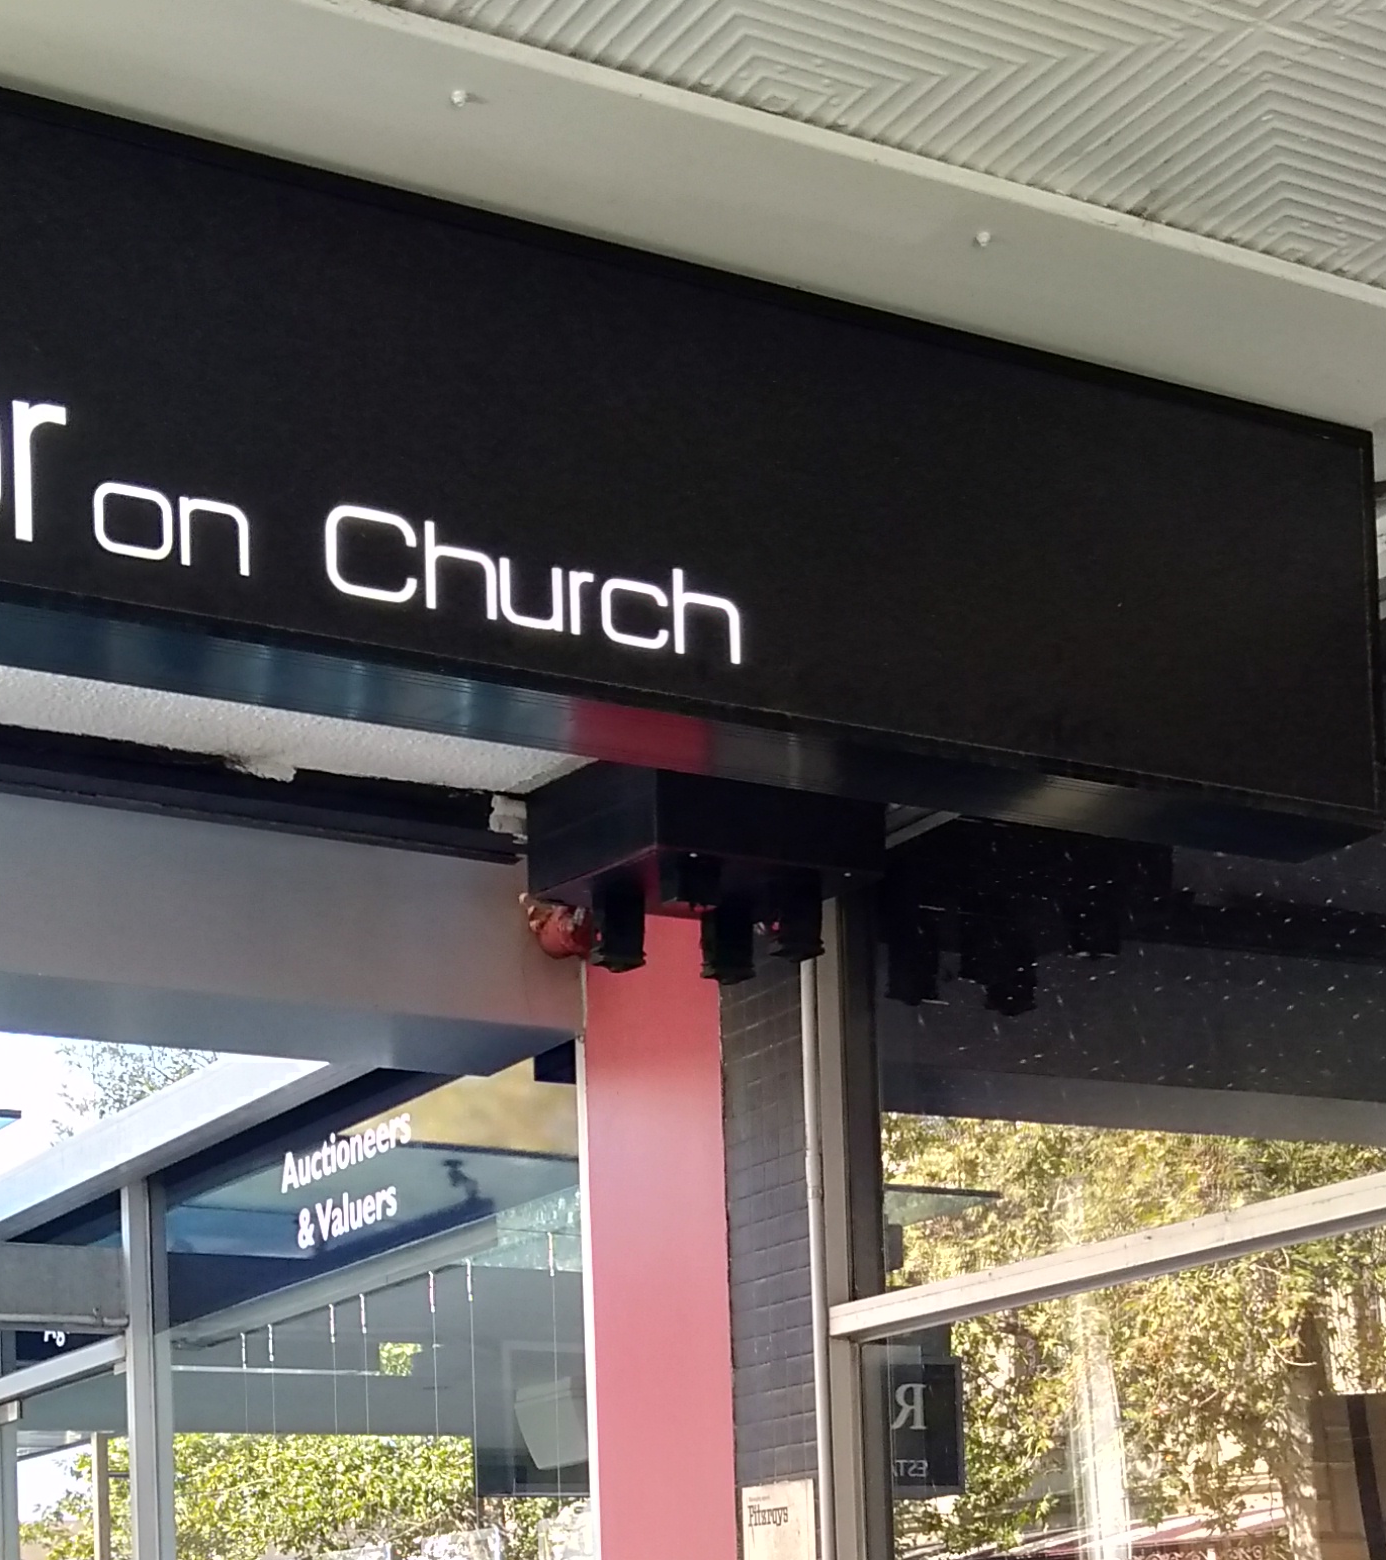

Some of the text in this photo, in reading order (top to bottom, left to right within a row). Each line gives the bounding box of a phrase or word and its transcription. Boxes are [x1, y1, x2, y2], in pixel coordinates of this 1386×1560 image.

[94, 481, 249, 577] on
[325, 504, 741, 665] Church
[281, 1112, 412, 1194] Auctioneers
[297, 1186, 398, 1250] & Valuers
